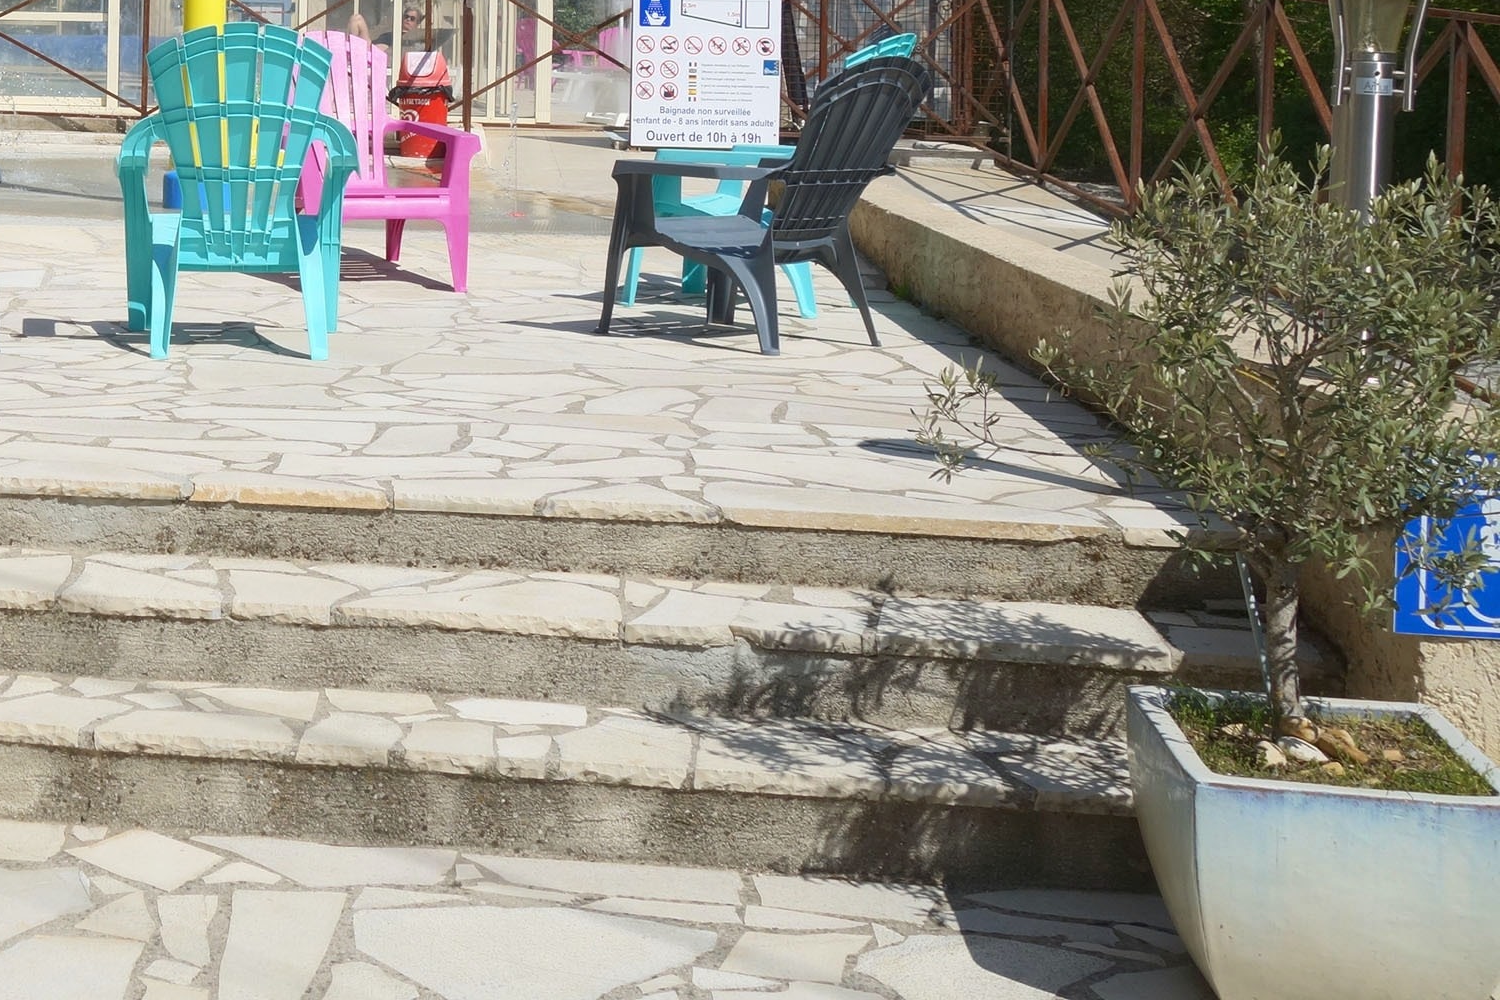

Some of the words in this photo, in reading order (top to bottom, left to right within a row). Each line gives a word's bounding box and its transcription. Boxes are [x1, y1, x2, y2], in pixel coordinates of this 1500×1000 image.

[659, 106, 696, 116] Baignade
[714, 107, 752, 116] surveillée
[662, 117, 672, 125] de
[646, 130, 685, 142] Ouvert
[688, 132, 703, 142] de
[707, 132, 727, 143] 10h
[730, 133, 737, 143] à
[741, 133, 762, 144] 19h
